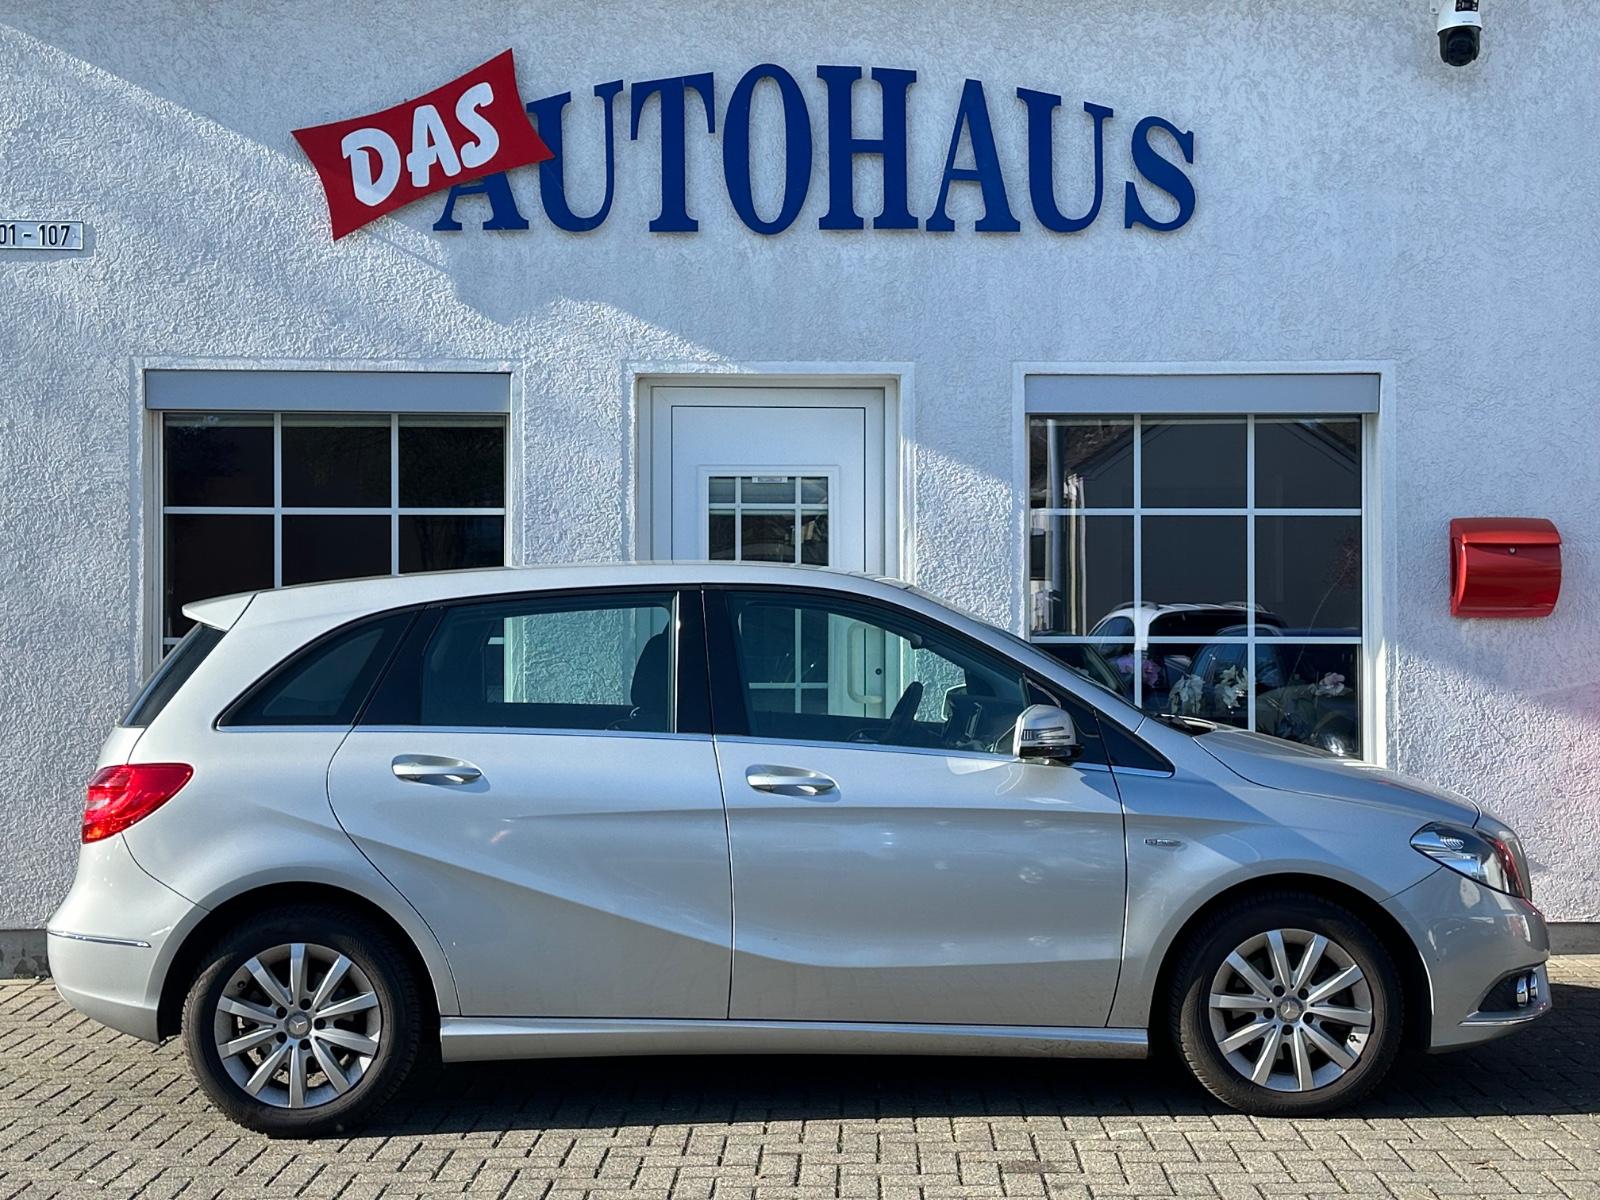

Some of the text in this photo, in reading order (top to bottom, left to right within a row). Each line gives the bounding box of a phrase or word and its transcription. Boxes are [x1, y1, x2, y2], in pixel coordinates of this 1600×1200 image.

[341, 81, 501, 207] DAS
[432, 63, 1196, 235] AUTOHAUS
[39, 224, 71, 246] 107
